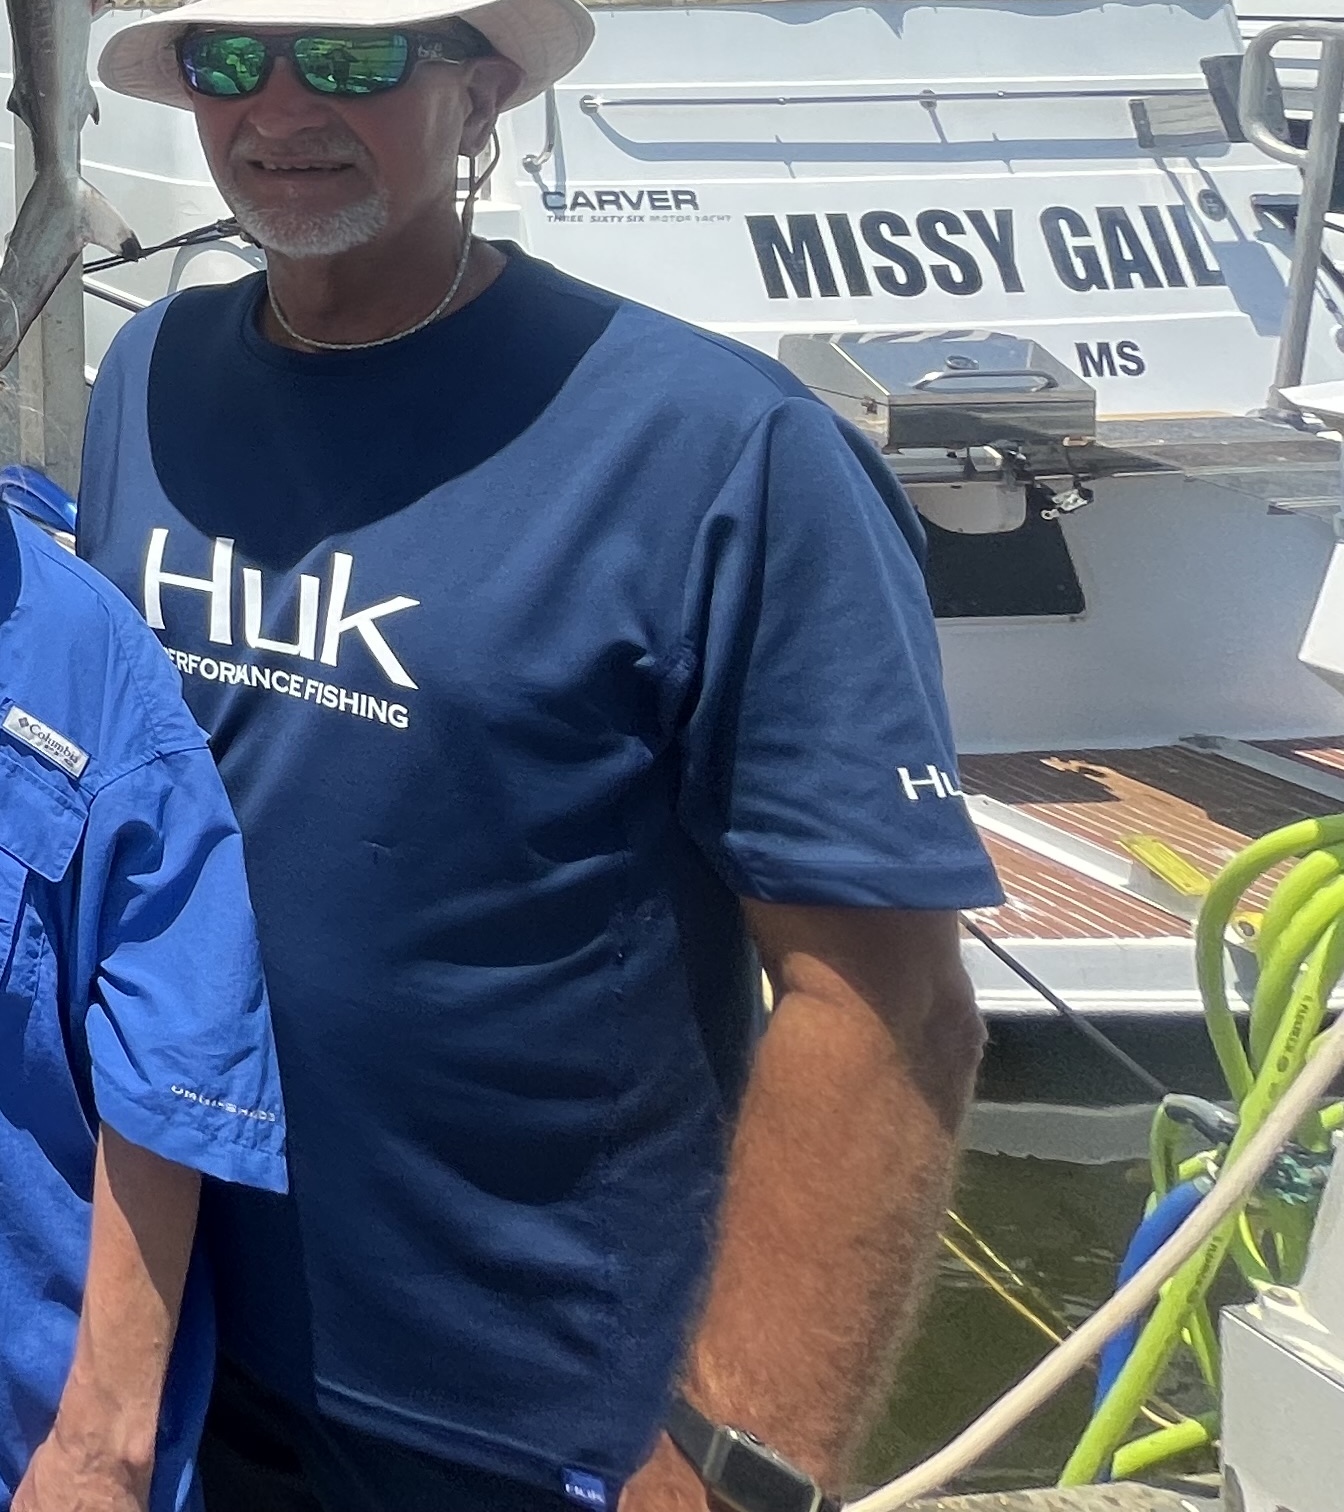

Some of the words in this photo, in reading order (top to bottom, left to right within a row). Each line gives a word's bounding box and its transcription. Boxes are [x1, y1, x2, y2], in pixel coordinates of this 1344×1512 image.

[542, 189, 700, 212] CARVER
[546, 215, 584, 223] THREE
[590, 215, 624, 223] SIXTY
[626, 215, 645, 223] SIX
[745, 205, 1025, 299] MISSY
[1039, 204, 1227, 292] GAIL
[1075, 338, 1145, 378] MS
[303, 677, 410, 730] FISHING
